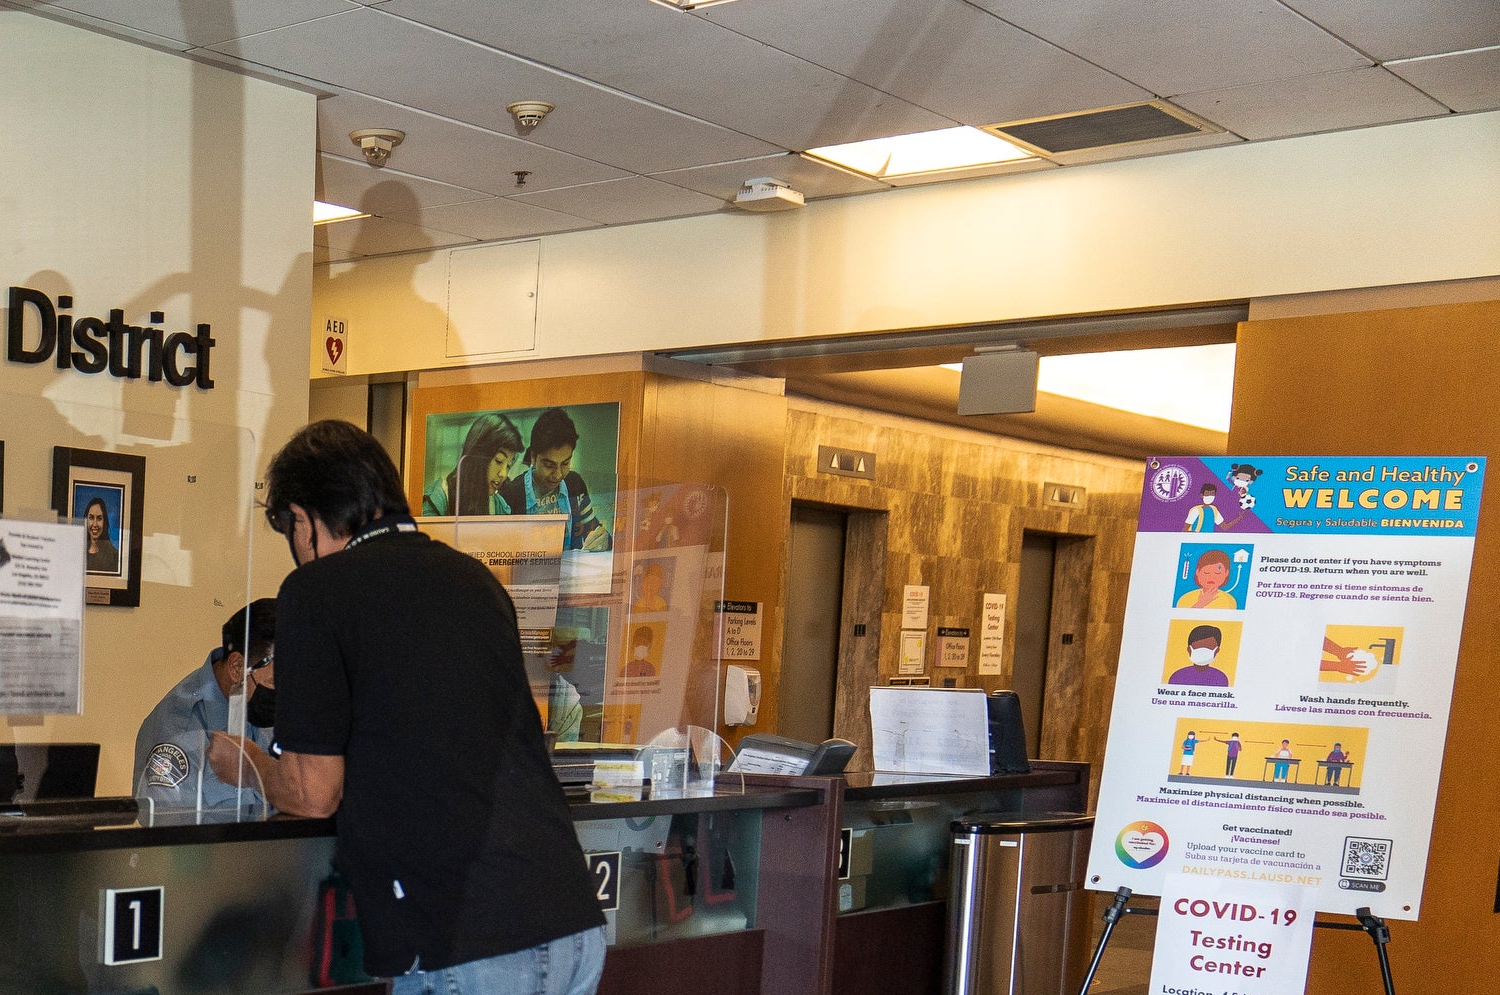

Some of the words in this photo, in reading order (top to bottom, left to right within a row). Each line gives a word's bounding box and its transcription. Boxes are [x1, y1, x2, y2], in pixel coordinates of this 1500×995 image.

[326, 320, 344, 334] AED
[8, 284, 216, 390] District
[1286, 465, 1329, 482] Safe
[1336, 466, 1374, 482] and
[1381, 466, 1466, 486] Healthy
[1282, 488, 1464, 510] WELCOME
[1277, 518, 1313, 528] Segura
[1381, 519, 1463, 528] BIENVENIDA
[530, 558, 561, 566] SERVICES
[1299, 592, 1334, 600] Regrese
[728, 617, 743, 626] Parking
[726, 638, 739, 646] Office
[741, 638, 753, 646] Floors
[1157, 688, 1180, 696] Wear
[1300, 695, 1324, 703] Wash
[1357, 698, 1409, 709] frequently.
[1377, 710, 1432, 719] frecuencia.
[158, 746, 186, 770] ANGELES
[1159, 787, 1203, 796] Maximize
[1204, 791, 1243, 799] physical
[1245, 793, 1294, 805] distancing
[1296, 797, 1321, 805] when
[1323, 800, 1365, 808] possible.
[1136, 795, 1180, 804] Maximice
[1191, 800, 1266, 811] distanciamiento
[1295, 808, 1330, 816] cuando
[1349, 812, 1386, 820] posible.
[1239, 827, 1292, 836] vaccinated!
[1187, 842, 1215, 854] Upload
[1240, 848, 1274, 856] vaccine
[1185, 852, 1206, 860] Suba
[1221, 856, 1248, 864] tarjeta
[596, 861, 610, 901] 2
[1182, 866, 1322, 886] DAILYPASS.LAUSD.NET
[1351, 882, 1368, 890] SCAN
[1174, 898, 1297, 926] COVID-19
[129, 900, 141, 950] 1
[1190, 930, 1272, 959] Testing
[1190, 955, 1266, 978] Center
